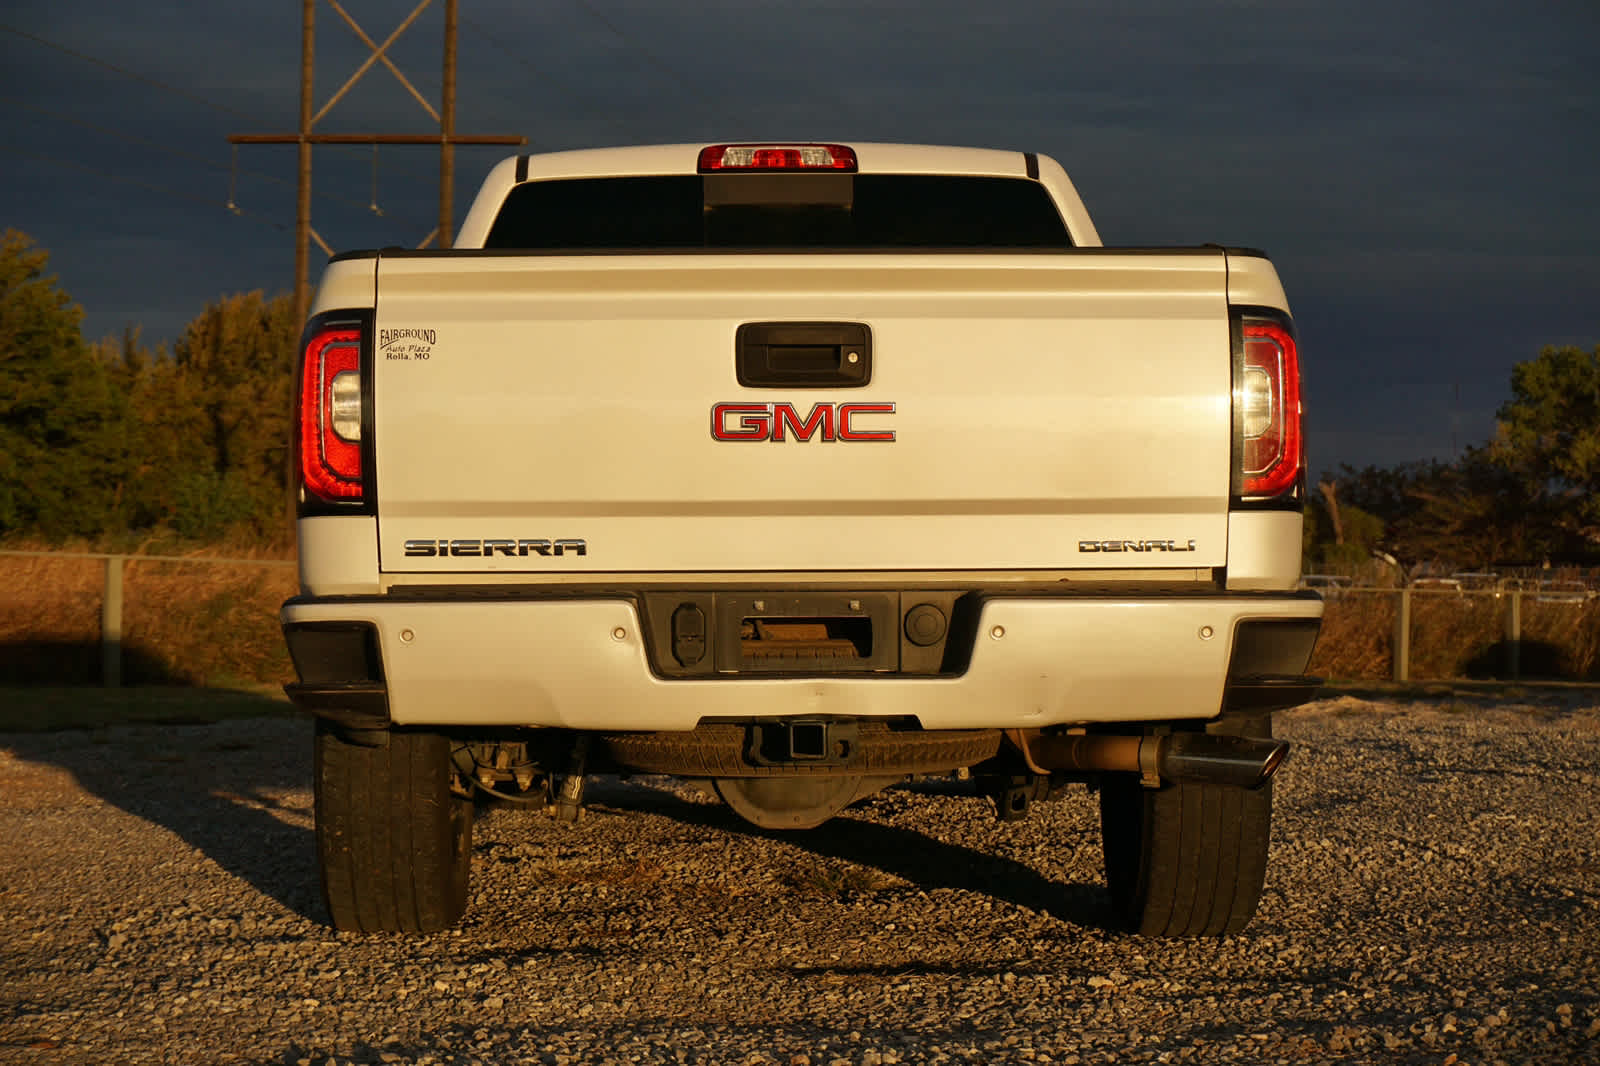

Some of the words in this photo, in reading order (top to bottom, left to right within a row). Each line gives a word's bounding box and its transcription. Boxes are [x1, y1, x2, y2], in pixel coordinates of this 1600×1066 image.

[380, 329, 436, 345] FAIRGROUND
[408, 344, 431, 352] Plaza
[711, 402, 896, 442] GMC
[404, 539, 587, 557] SIERRA
[1079, 540, 1196, 552] DENALI
